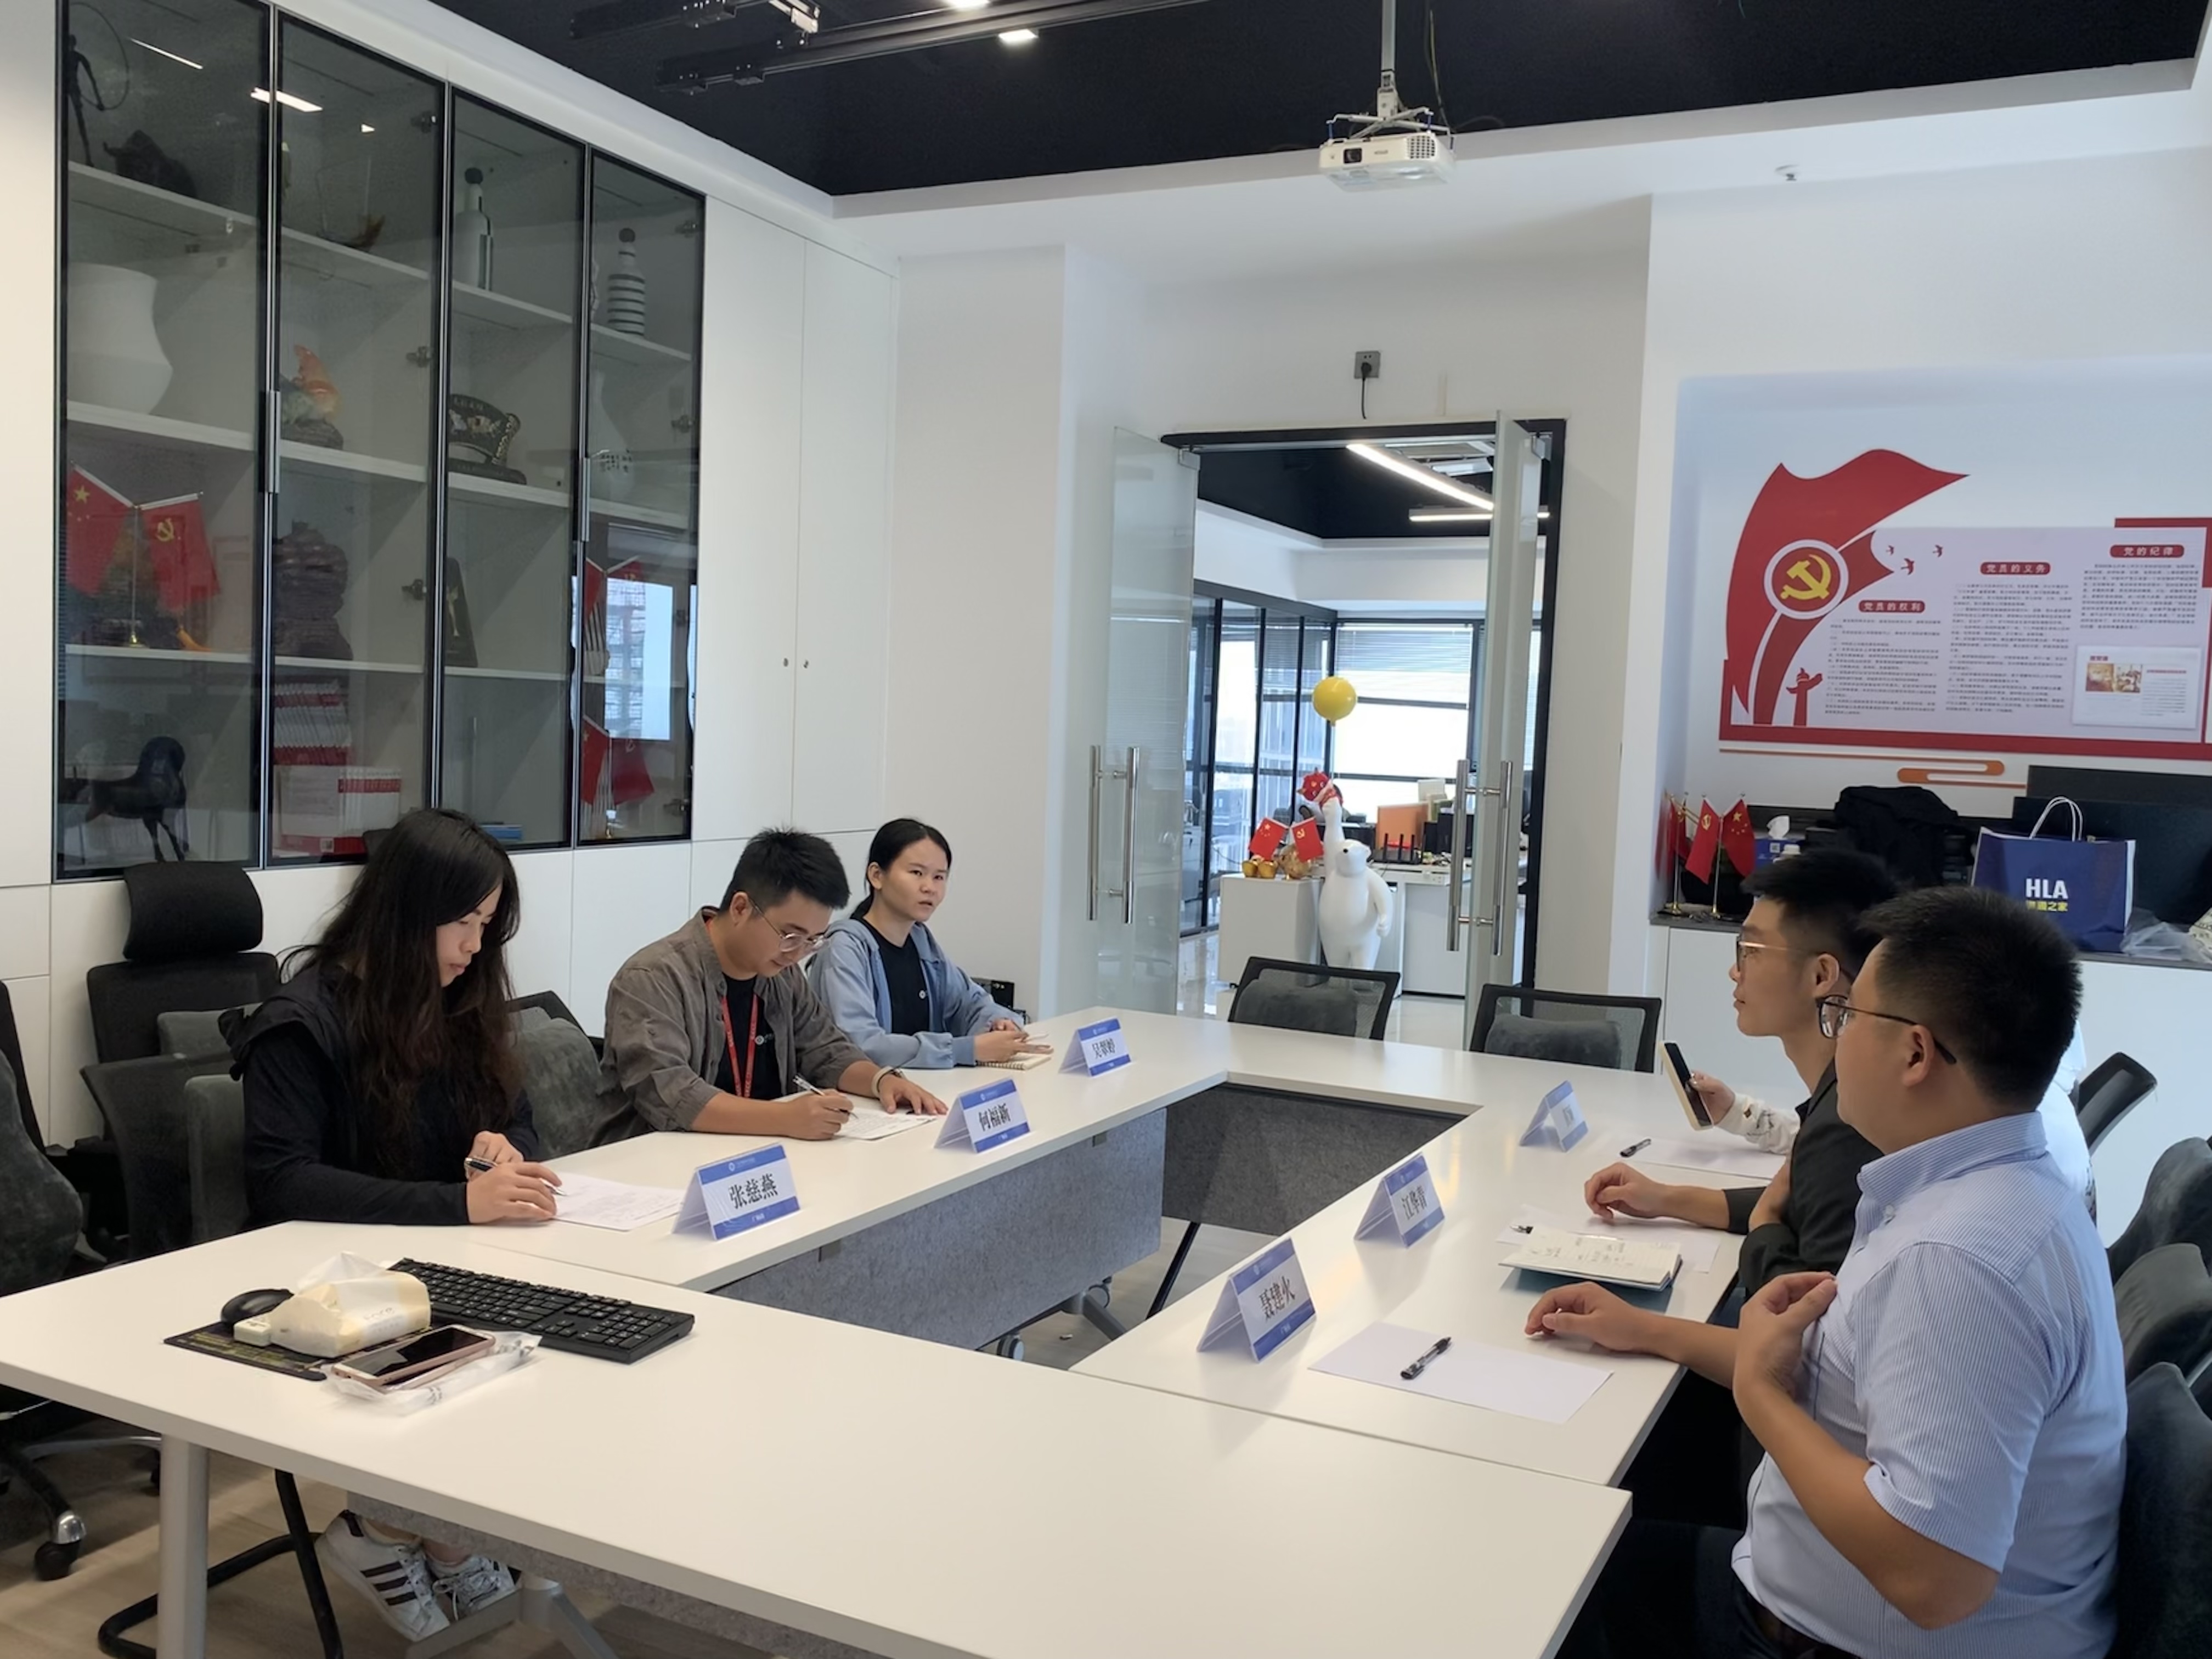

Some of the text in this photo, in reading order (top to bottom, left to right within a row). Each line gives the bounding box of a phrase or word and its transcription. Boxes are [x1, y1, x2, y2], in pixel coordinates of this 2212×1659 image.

[1987, 564, 2045, 573] 党员的义务
[1864, 602, 1921, 611] 党员的权利
[2025, 878, 2068, 899] HLA
[729, 1173, 778, 1209] 张慈燕
